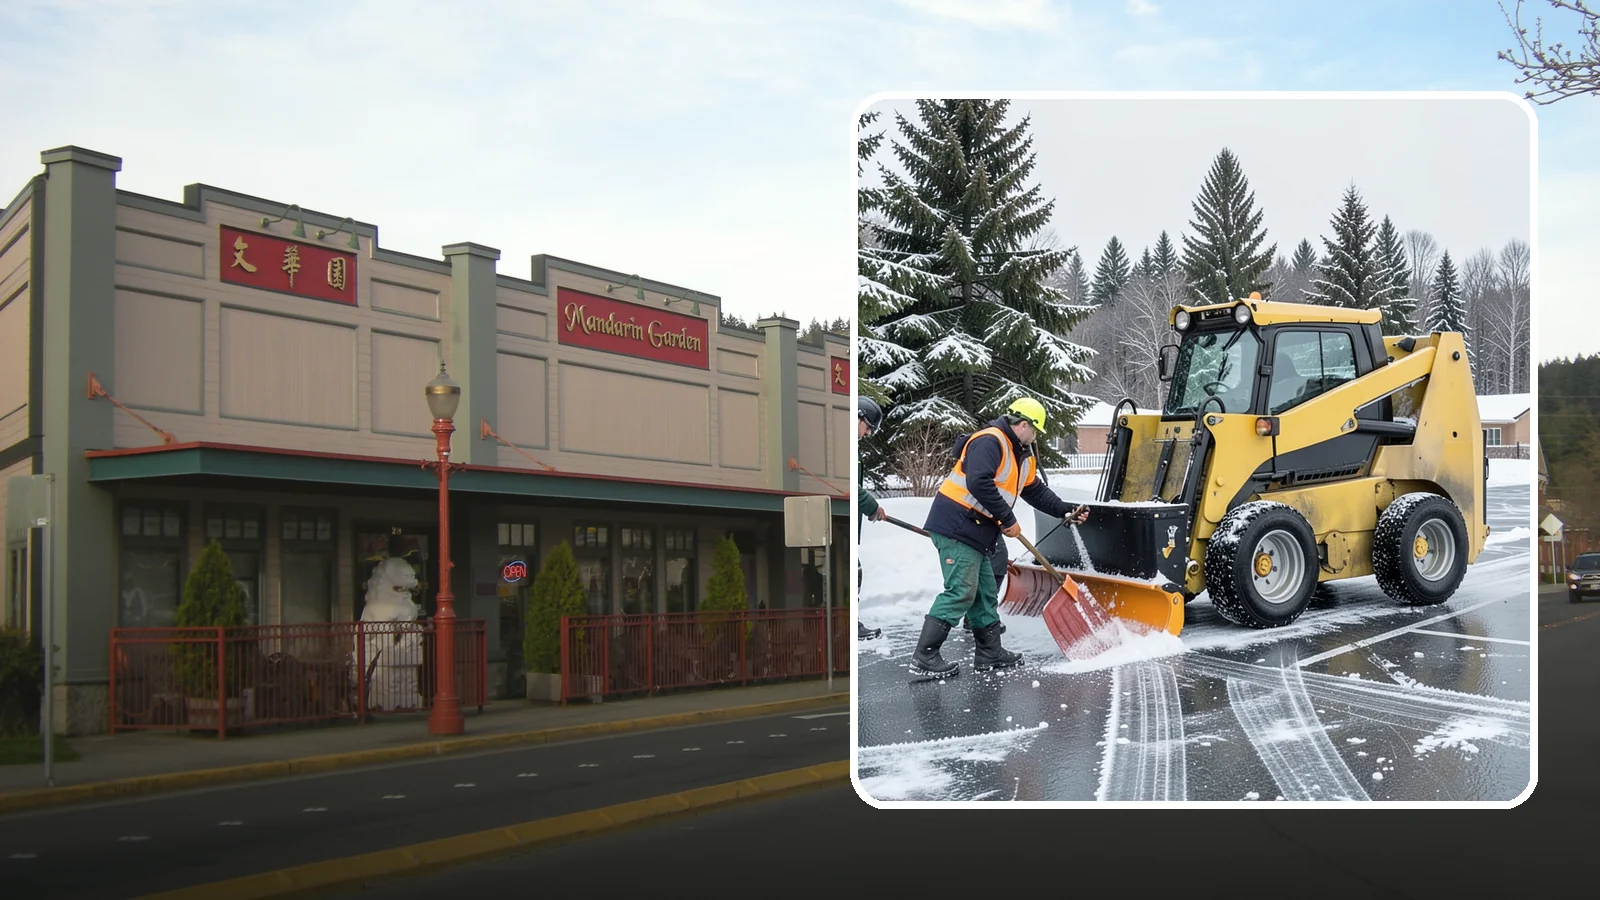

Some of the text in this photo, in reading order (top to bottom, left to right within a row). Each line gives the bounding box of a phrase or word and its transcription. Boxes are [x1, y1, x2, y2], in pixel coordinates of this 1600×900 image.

[231, 235, 346, 291] 文華園
[564, 302, 702, 352] Mandarin Garden
[503, 565, 527, 578] OPEN
